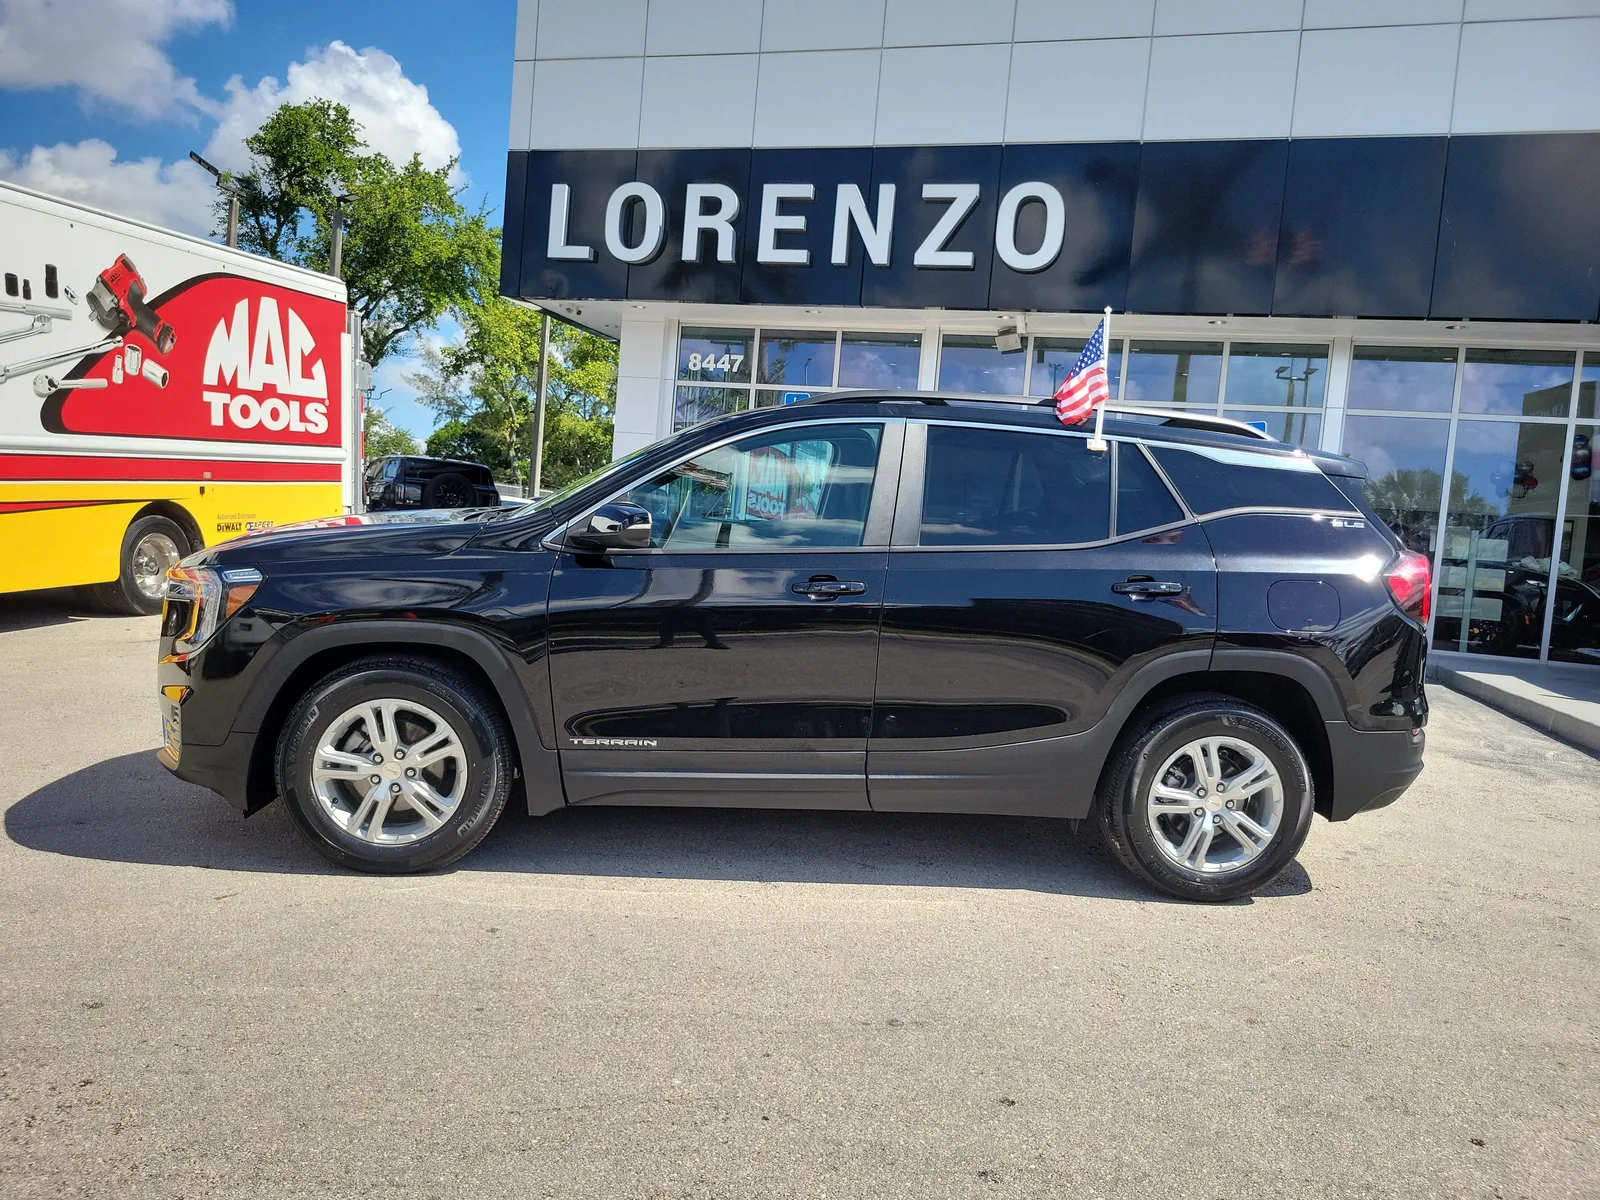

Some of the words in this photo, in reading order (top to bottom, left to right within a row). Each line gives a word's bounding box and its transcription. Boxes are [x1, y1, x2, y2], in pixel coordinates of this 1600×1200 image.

[546, 181, 1065, 272] LORENZO
[203, 296, 328, 399] MAC
[689, 353, 744, 372] 8447
[202, 391, 329, 434] TOOLS
[569, 738, 658, 746] TERRAIN
